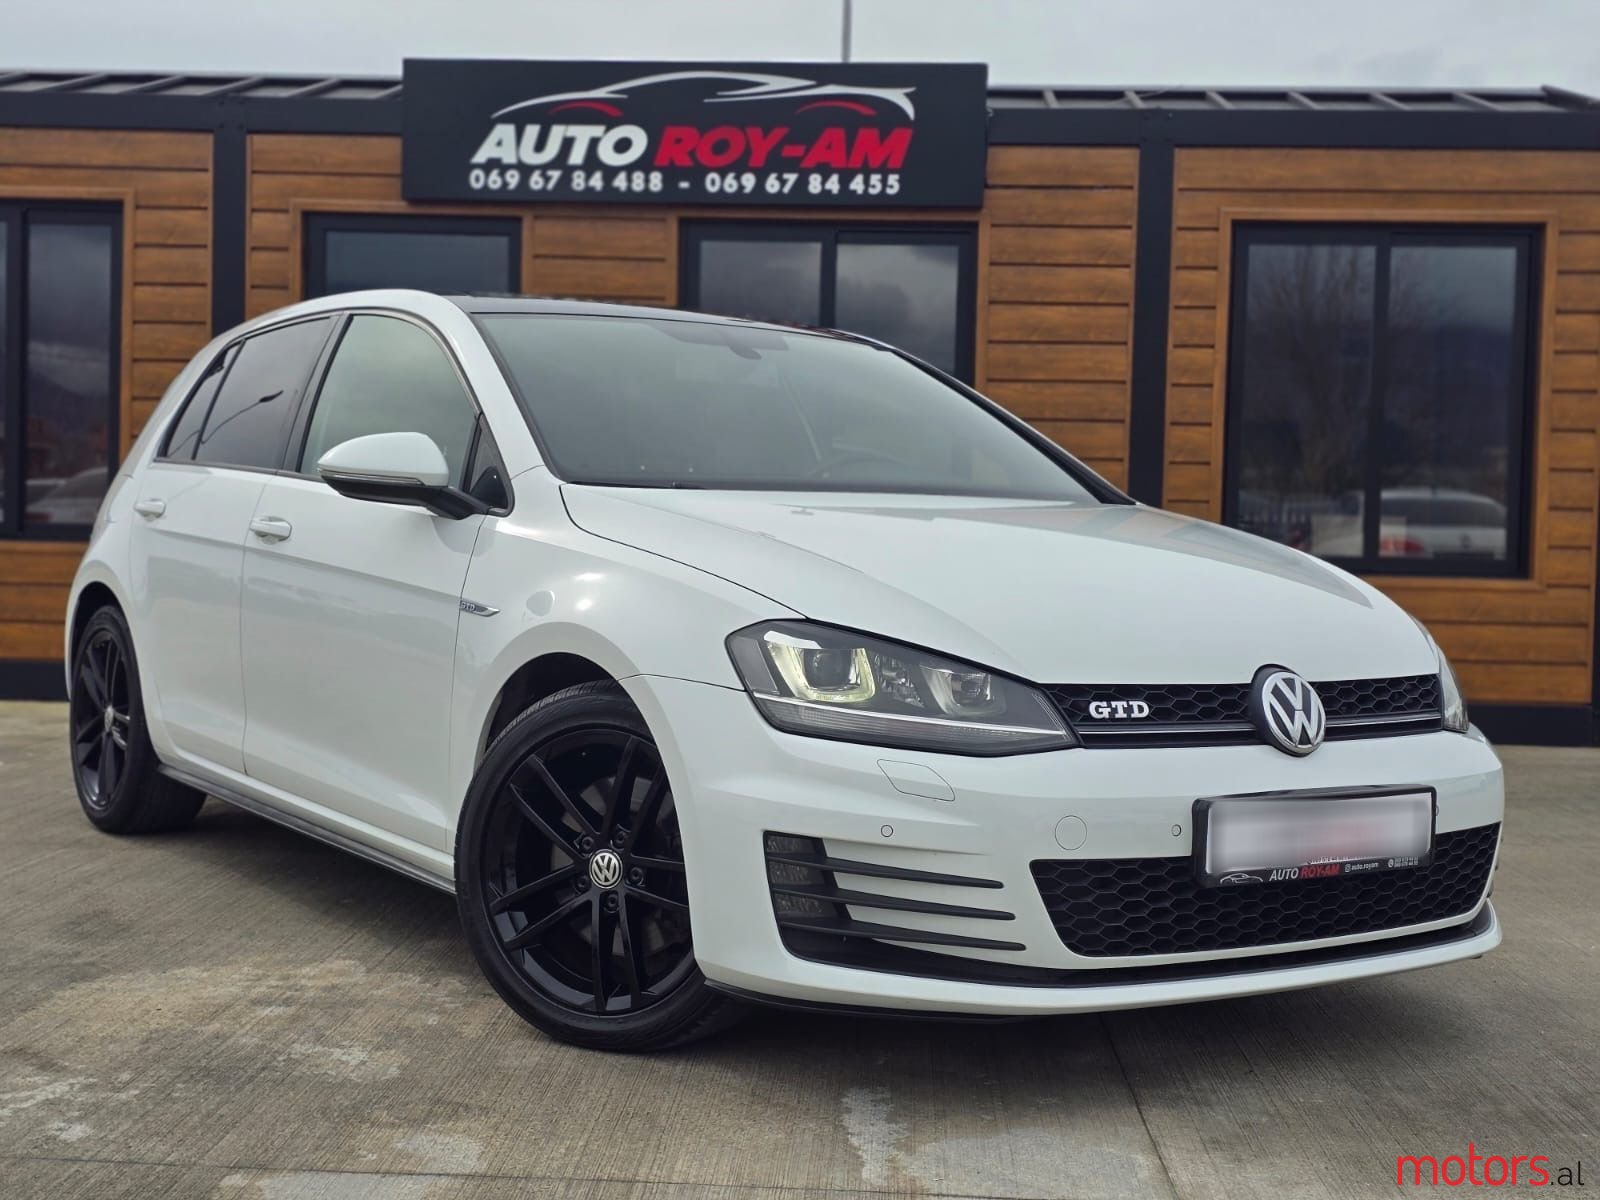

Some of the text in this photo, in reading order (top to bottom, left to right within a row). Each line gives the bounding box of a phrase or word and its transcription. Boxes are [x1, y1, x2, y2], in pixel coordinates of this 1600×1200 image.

[470, 124, 913, 169] AUTO ROY-AM
[469, 168, 520, 190] 069
[529, 169, 562, 190] 67
[571, 170, 604, 192] 84
[612, 171, 663, 192] 488
[705, 172, 756, 194] 069
[765, 173, 799, 194] 67
[808, 173, 840, 195] 84
[849, 173, 900, 195] 455
[1089, 701, 1150, 719] GTD
[1269, 867, 1299, 881] AUTO
[1301, 864, 1340, 878] ROY-AM
